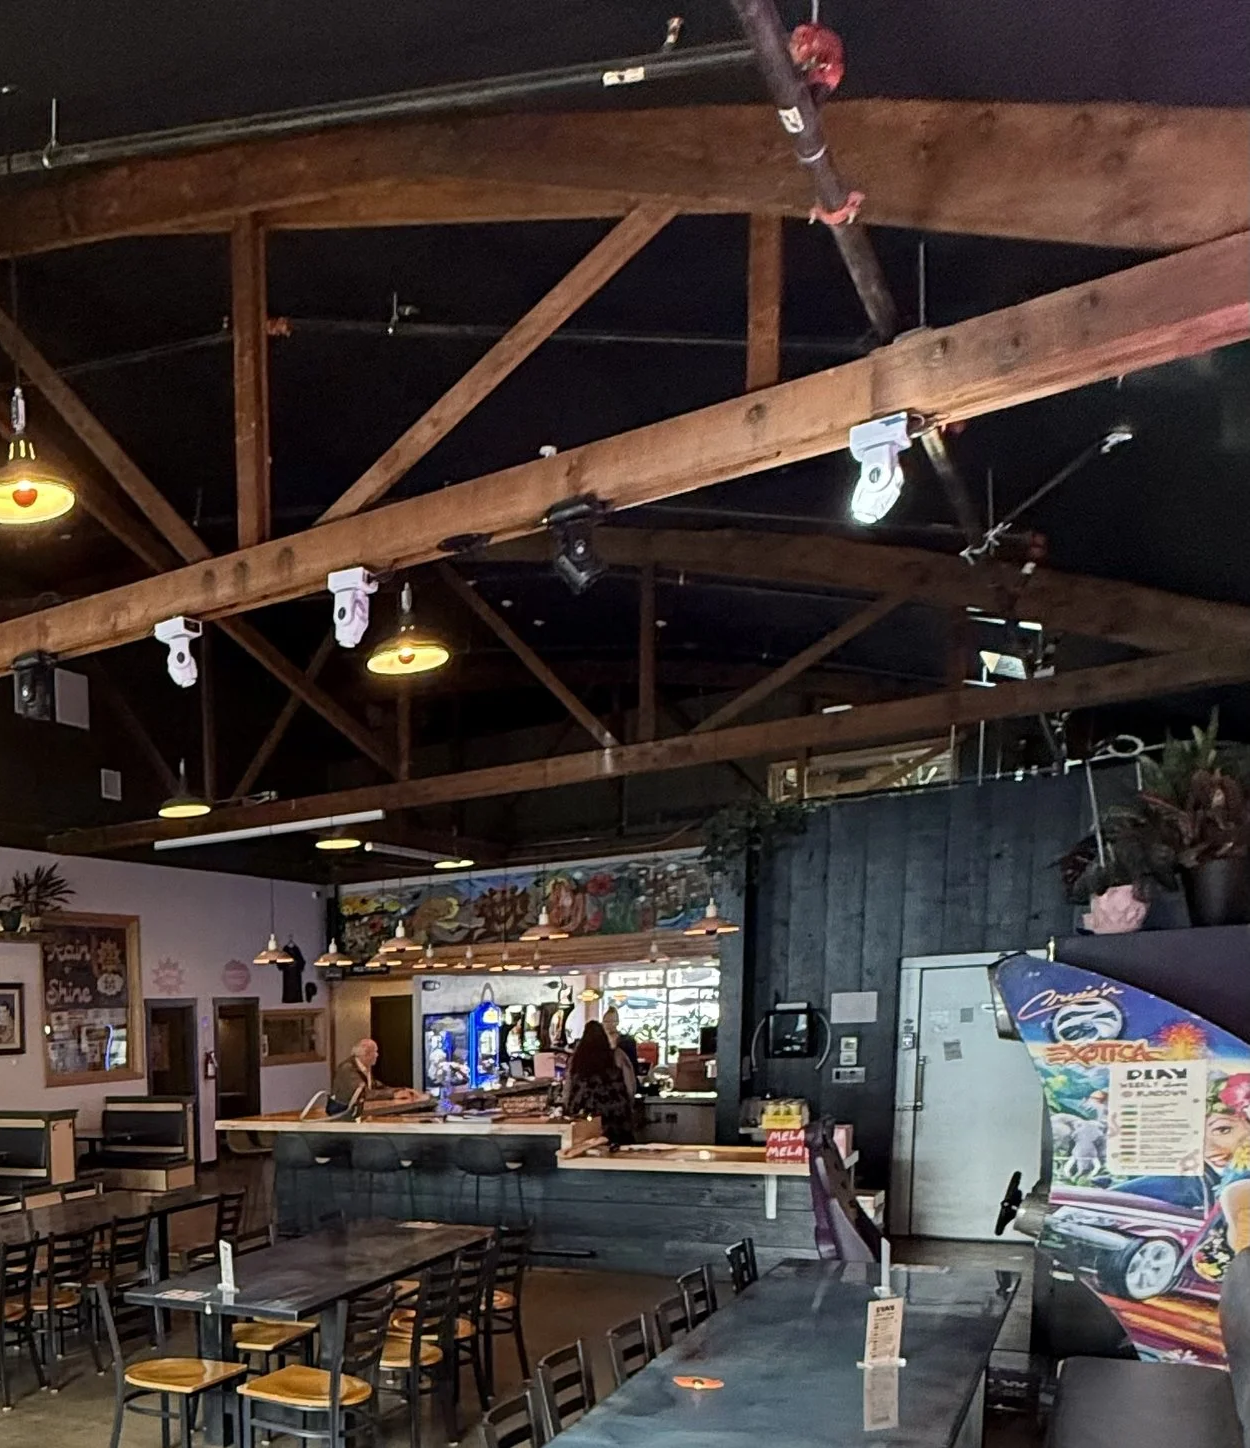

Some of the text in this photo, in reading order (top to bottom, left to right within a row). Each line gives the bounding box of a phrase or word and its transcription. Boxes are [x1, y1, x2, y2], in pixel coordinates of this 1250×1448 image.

[46, 978, 92, 1004] Shine
[1046, 1041, 1163, 1064] EXOTICA
[1127, 1068, 1188, 1080] PLAY
[769, 1129, 805, 1142] MELA
[766, 1145, 803, 1158] MELA
